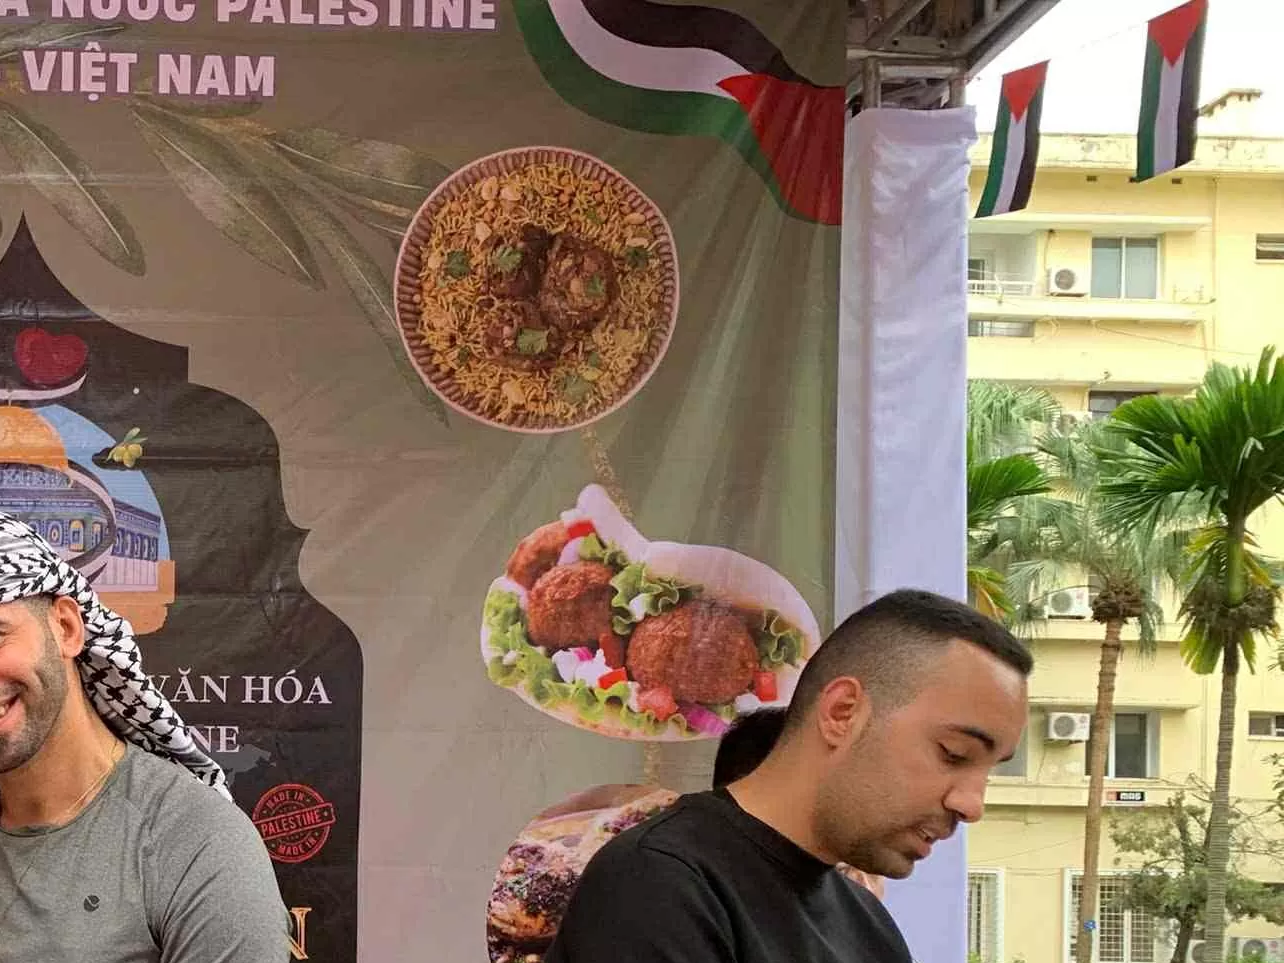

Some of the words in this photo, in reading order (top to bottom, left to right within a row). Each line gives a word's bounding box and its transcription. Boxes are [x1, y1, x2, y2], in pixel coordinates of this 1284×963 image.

[22, 41, 138, 100] VIỆT
[159, 54, 276, 96] NAM
[241, 672, 332, 705] HÓA
[266, 791, 290, 809] MADE
[293, 791, 305, 801] IN
[261, 810, 321, 838] PALESTINE
[278, 841, 305, 856] MADE
